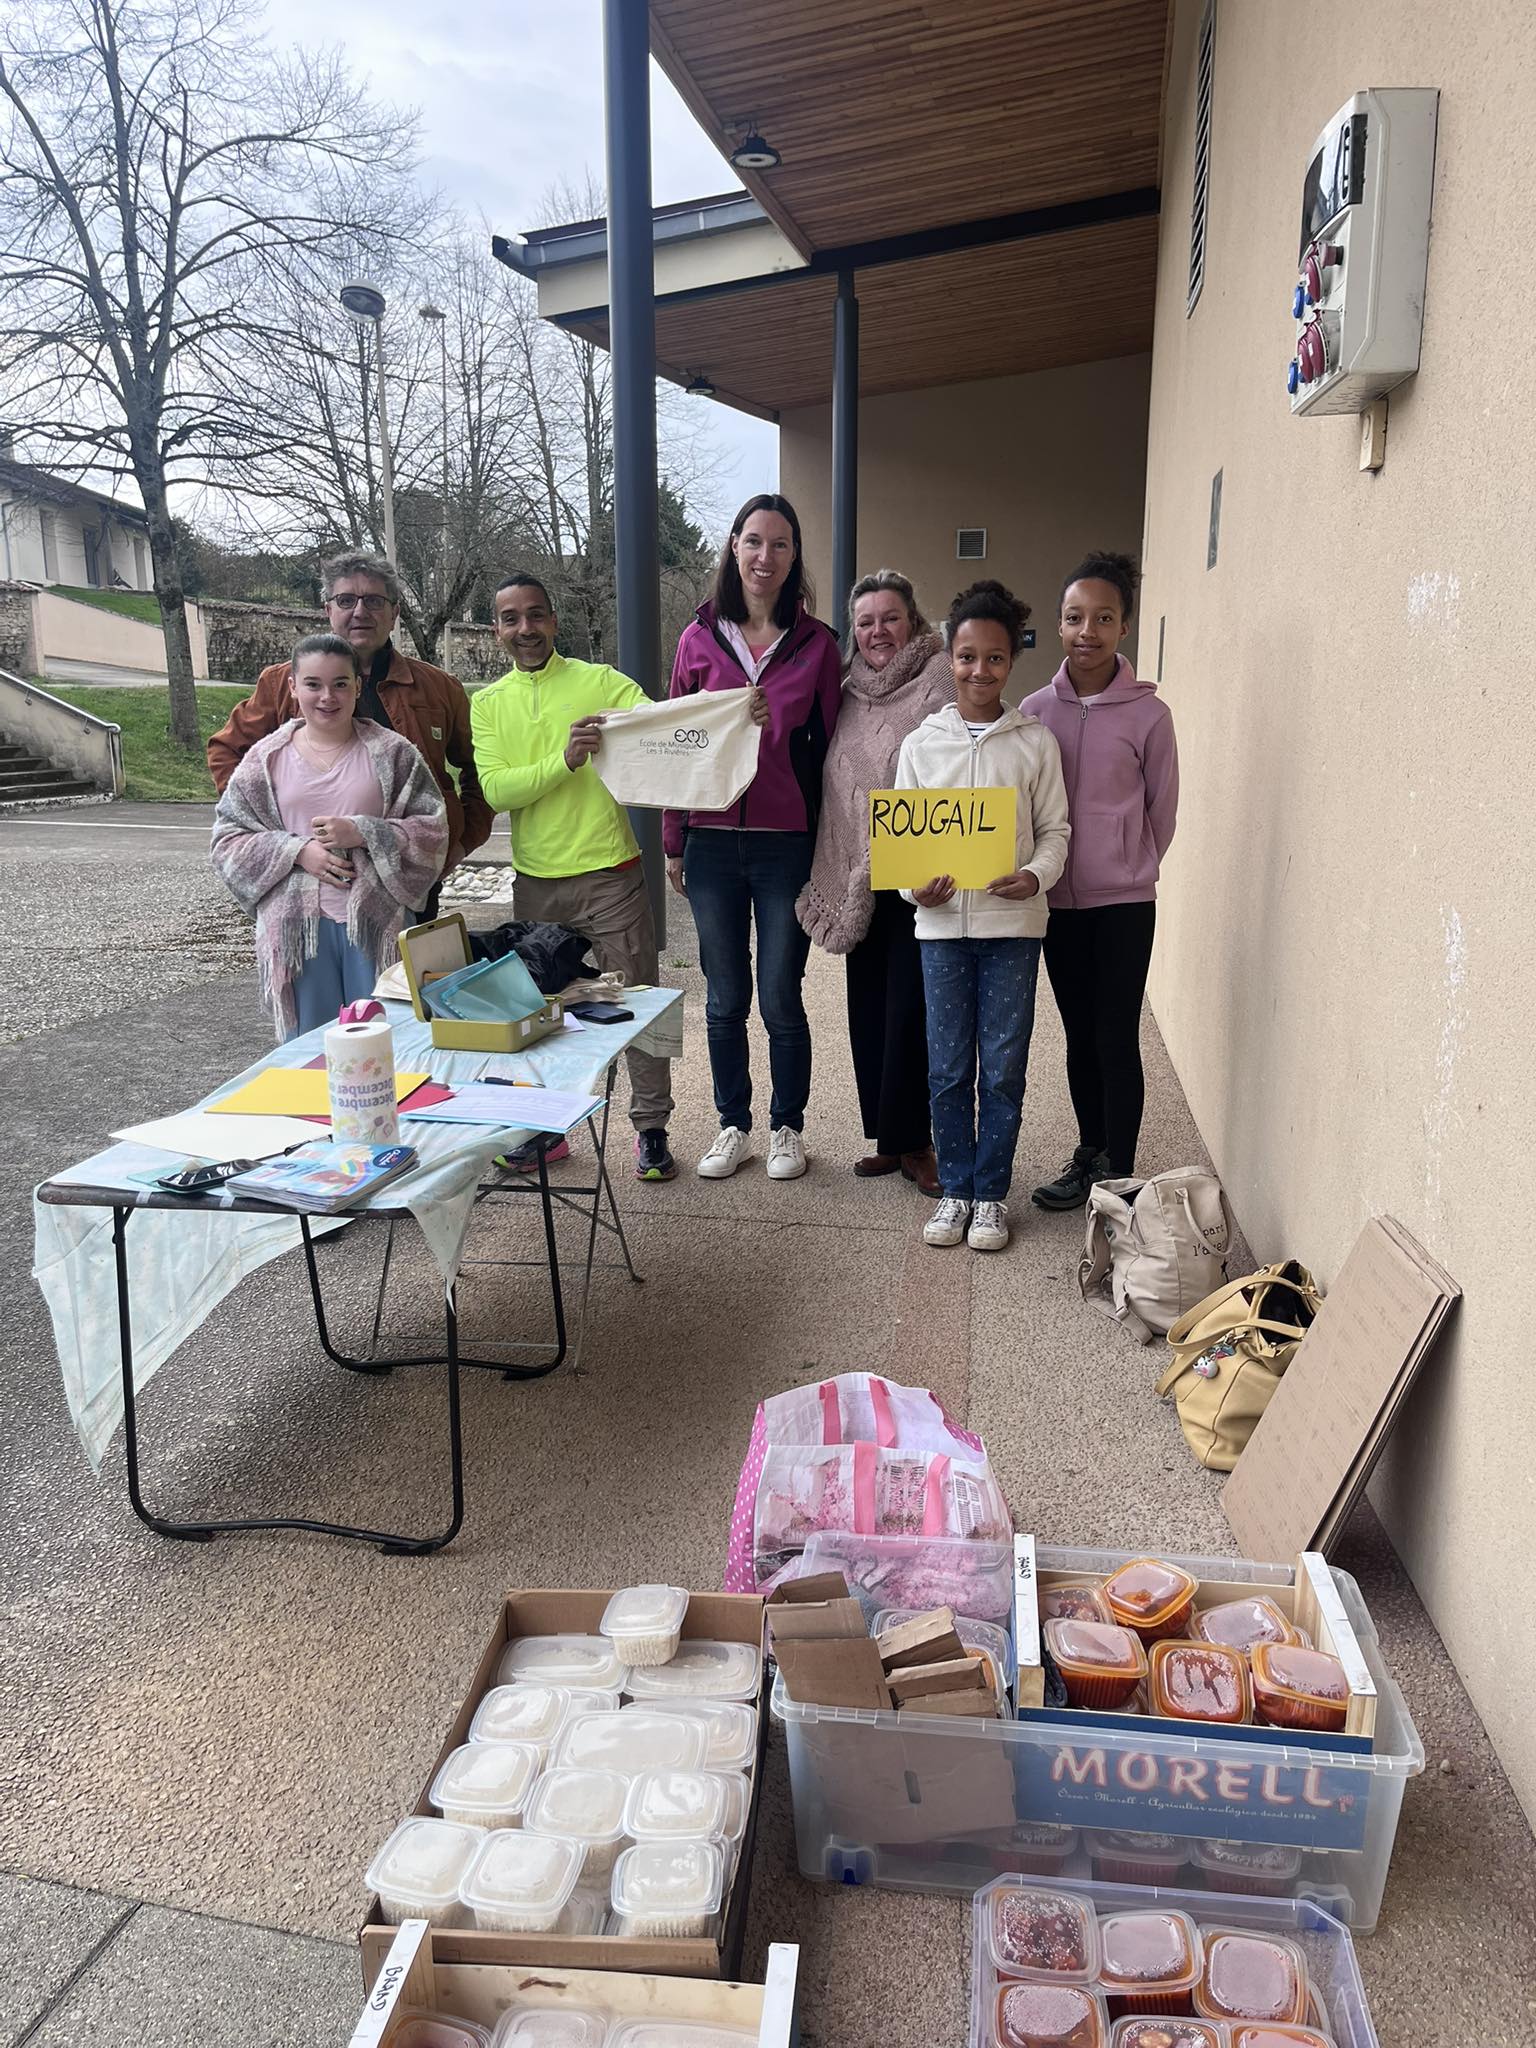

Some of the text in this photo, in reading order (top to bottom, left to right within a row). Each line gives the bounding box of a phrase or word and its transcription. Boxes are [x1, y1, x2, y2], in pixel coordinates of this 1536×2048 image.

[658, 740, 667, 748] de
[668, 741, 698, 750] Musique
[646, 747, 657, 755] Les
[1051, 1743, 1333, 1809] MORELL
